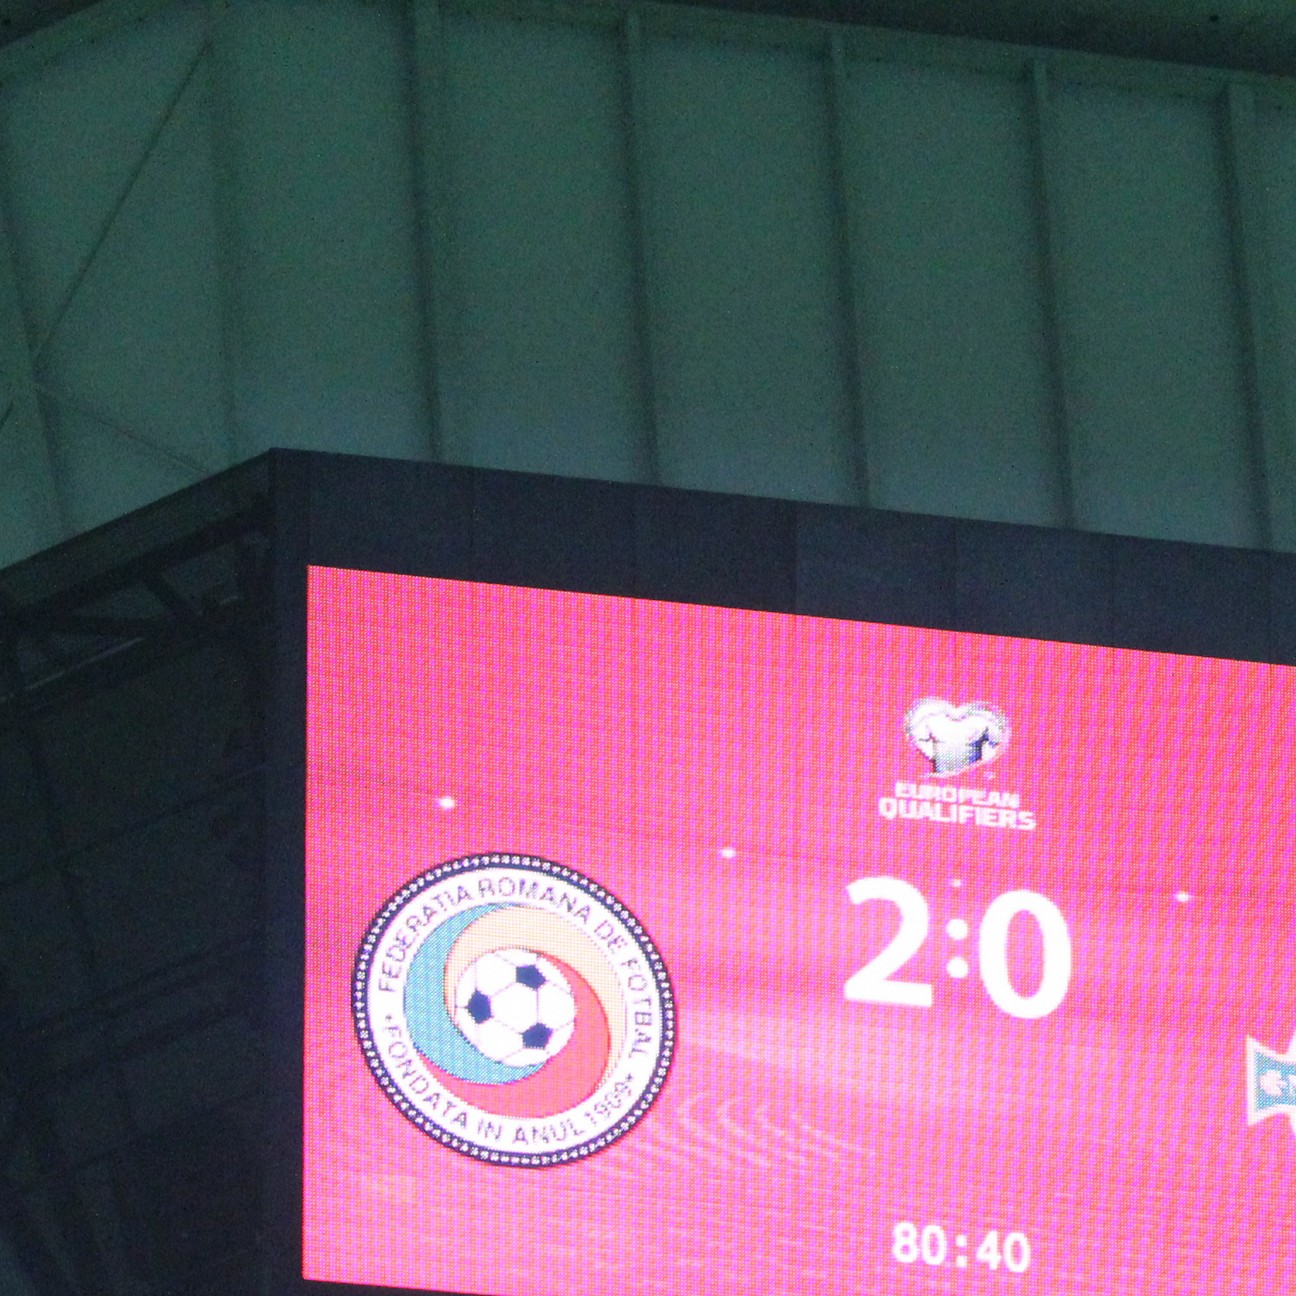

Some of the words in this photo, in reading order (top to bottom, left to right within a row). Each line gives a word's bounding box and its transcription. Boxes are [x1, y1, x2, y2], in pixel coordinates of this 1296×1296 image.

[878, 796, 1037, 831] QUALIFIERS
[894, 780, 1021, 809] EUROPEAN
[477, 876, 592, 926] ROMANA
[592, 918, 630, 954] DE
[620, 956, 655, 1059] FOTBAL
[843, 875, 1073, 1019] 2:0
[477, 1117, 504, 1144] IN
[511, 1117, 586, 1146] ANUL
[891, 1220, 1032, 1273] 80:40
